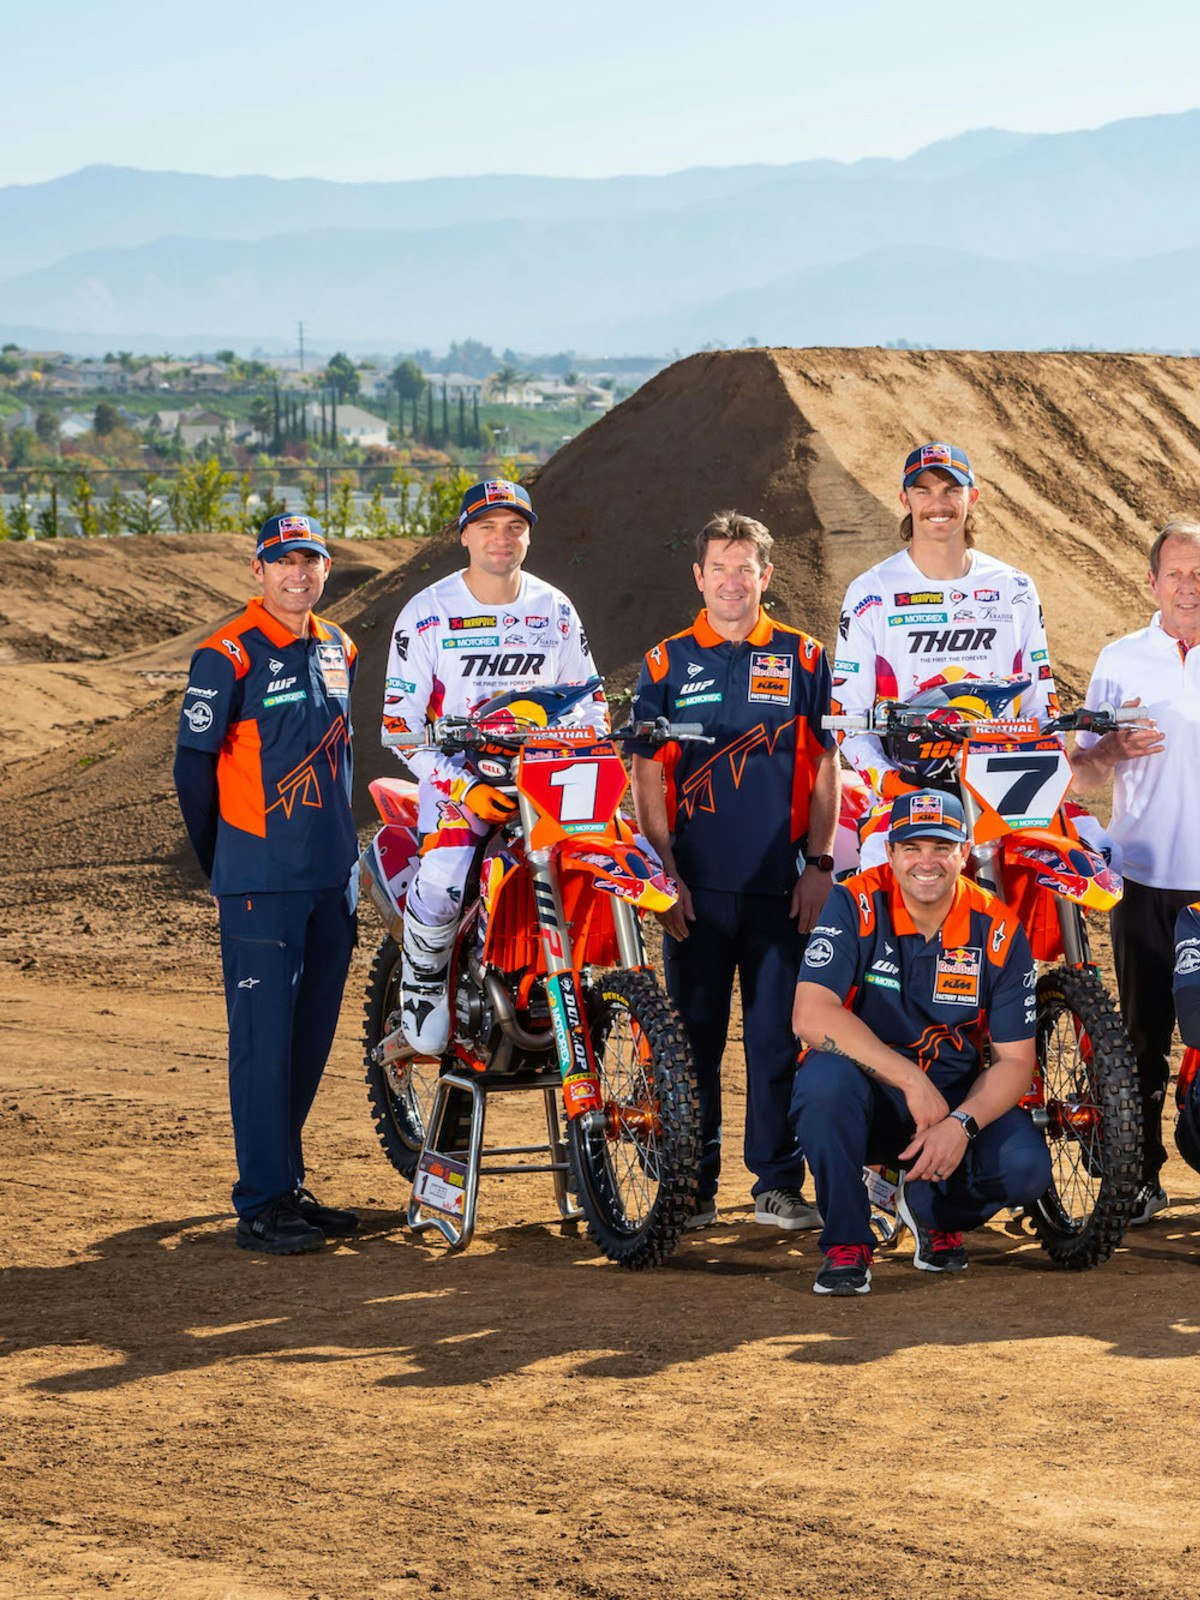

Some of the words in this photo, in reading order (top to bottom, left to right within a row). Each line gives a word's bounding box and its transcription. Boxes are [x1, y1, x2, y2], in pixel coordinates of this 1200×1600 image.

[904, 614, 944, 624] MOTOREX
[457, 637, 497, 647] MOTOREX
[907, 628, 997, 654] THOR
[460, 653, 546, 677] THOR
[757, 681, 784, 691] KTM
[481, 763, 501, 774] BELL
[550, 762, 599, 822] 1
[986, 755, 1059, 816] 7
[1019, 819, 1049, 827] MOTOREX
[939, 960, 958, 972] Red
[959, 963, 979, 975] Bull
[943, 978, 972, 990] KTM
[552, 1007, 570, 1066] MOTOREX
[421, 1174, 428, 1195] 1
